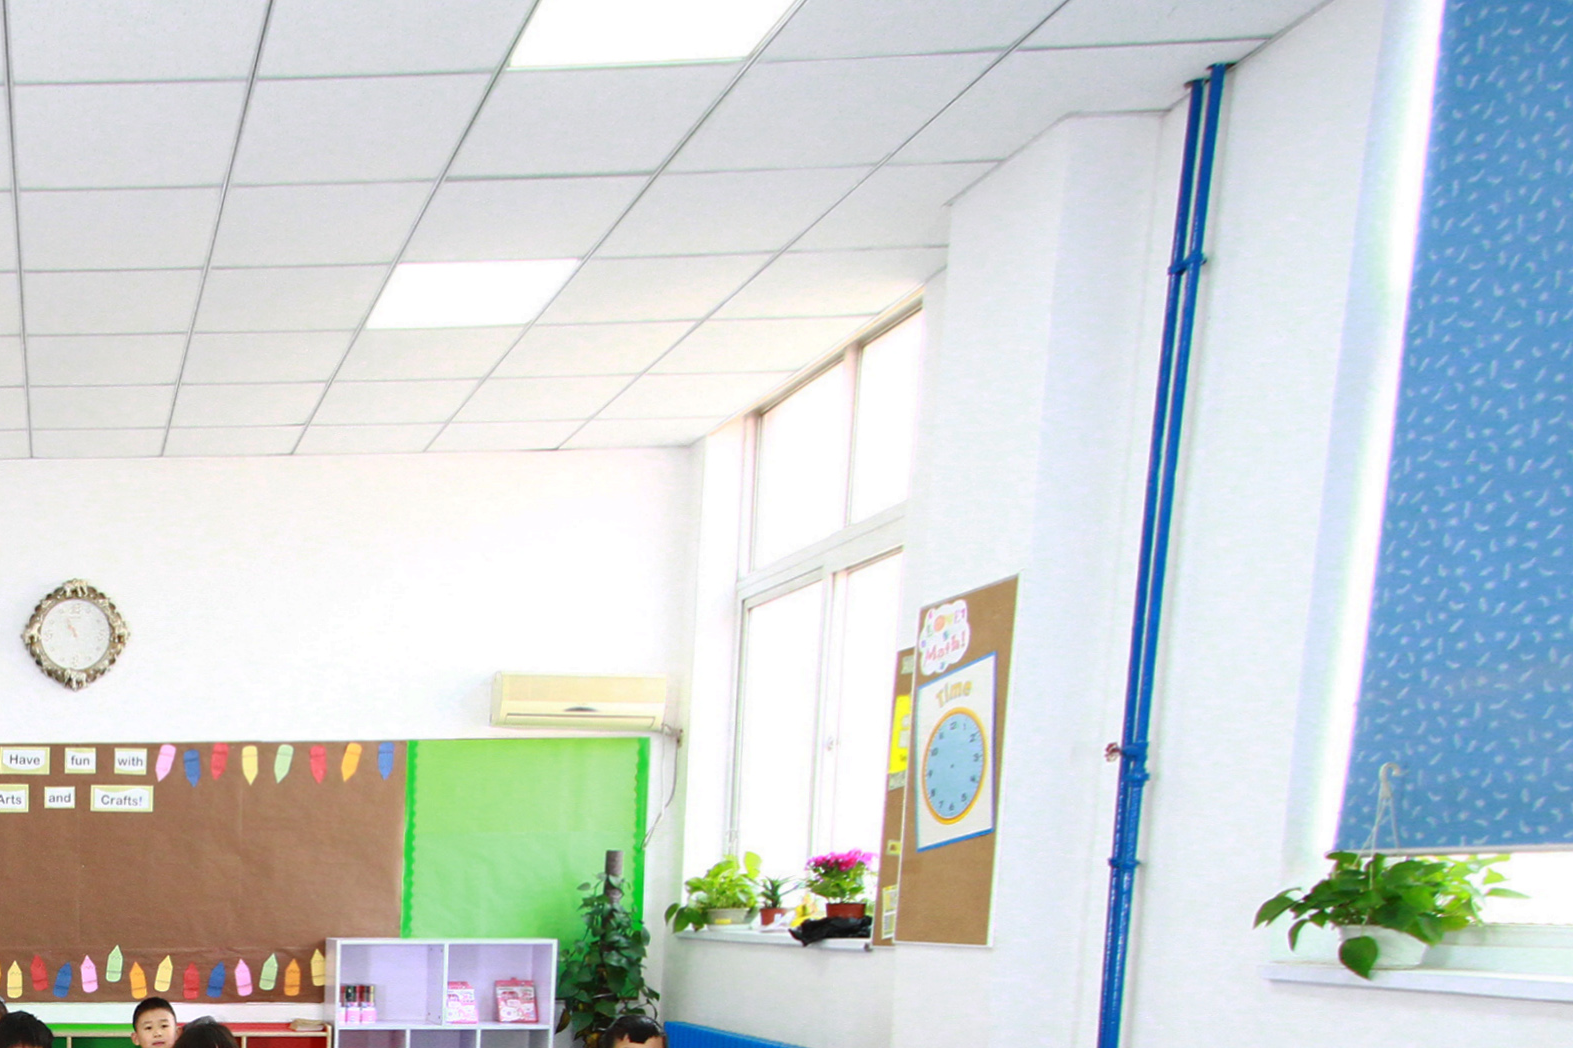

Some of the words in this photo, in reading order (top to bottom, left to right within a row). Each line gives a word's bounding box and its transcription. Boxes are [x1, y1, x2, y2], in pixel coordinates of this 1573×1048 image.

[935, 681, 972, 708] Time
[9, 754, 41, 766] Have
[71, 755, 90, 766] fun
[117, 756, 144, 767] with
[48, 793, 72, 803] and
[100, 794, 143, 806] Crafts!
